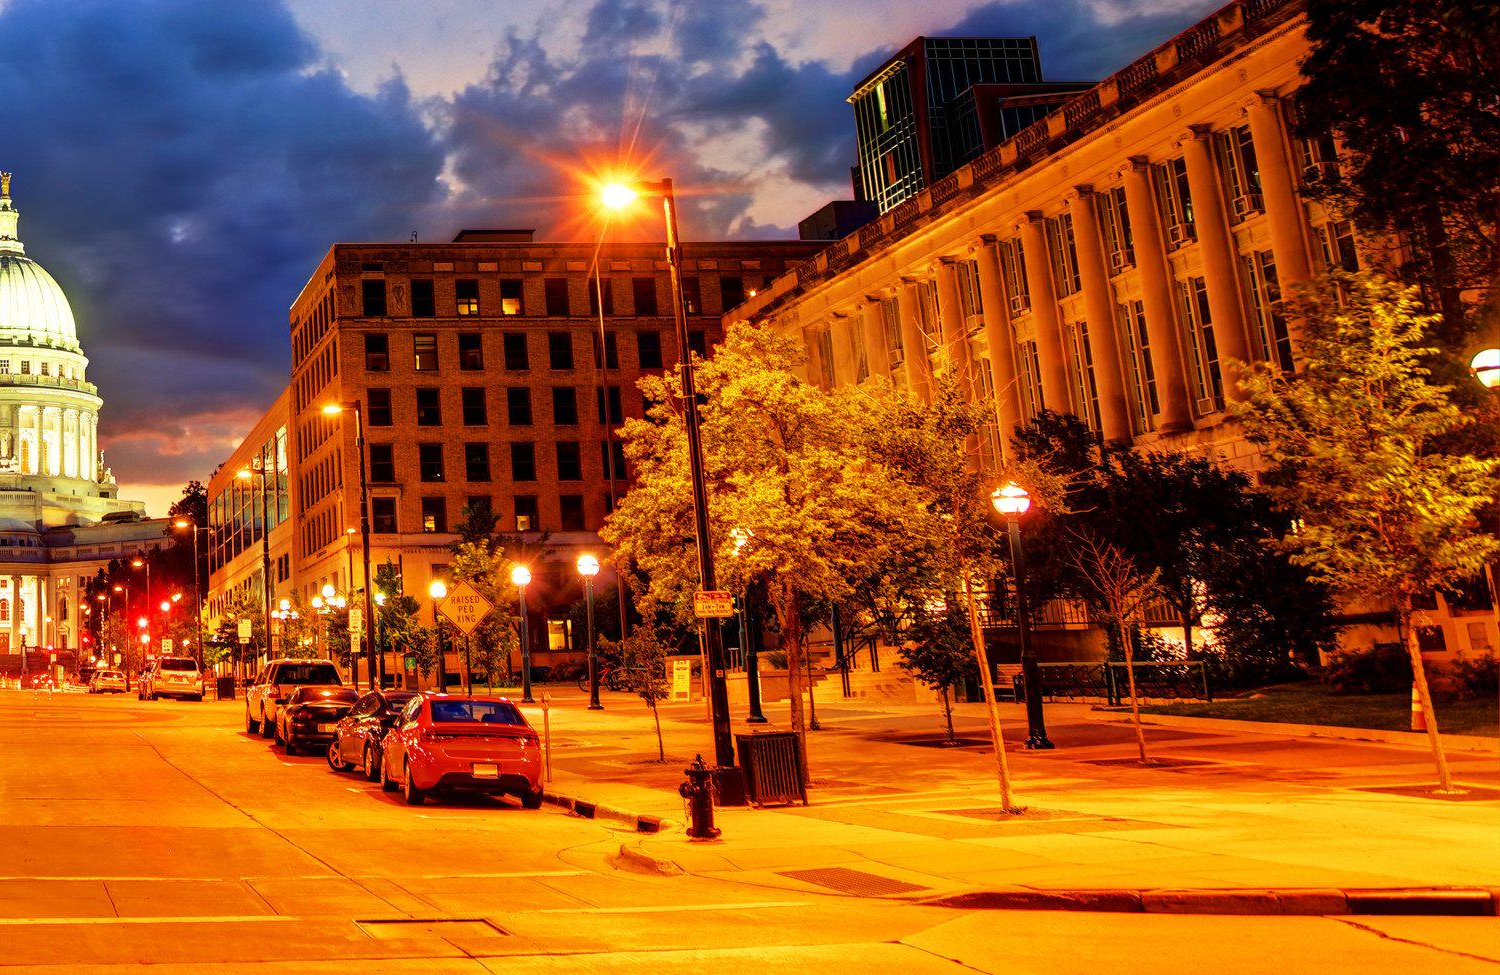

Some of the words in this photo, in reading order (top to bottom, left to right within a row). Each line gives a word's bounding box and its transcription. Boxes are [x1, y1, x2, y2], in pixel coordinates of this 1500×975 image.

[451, 595, 480, 604] RAISED
[458, 605, 475, 613] PED
[456, 614, 476, 623] XING
